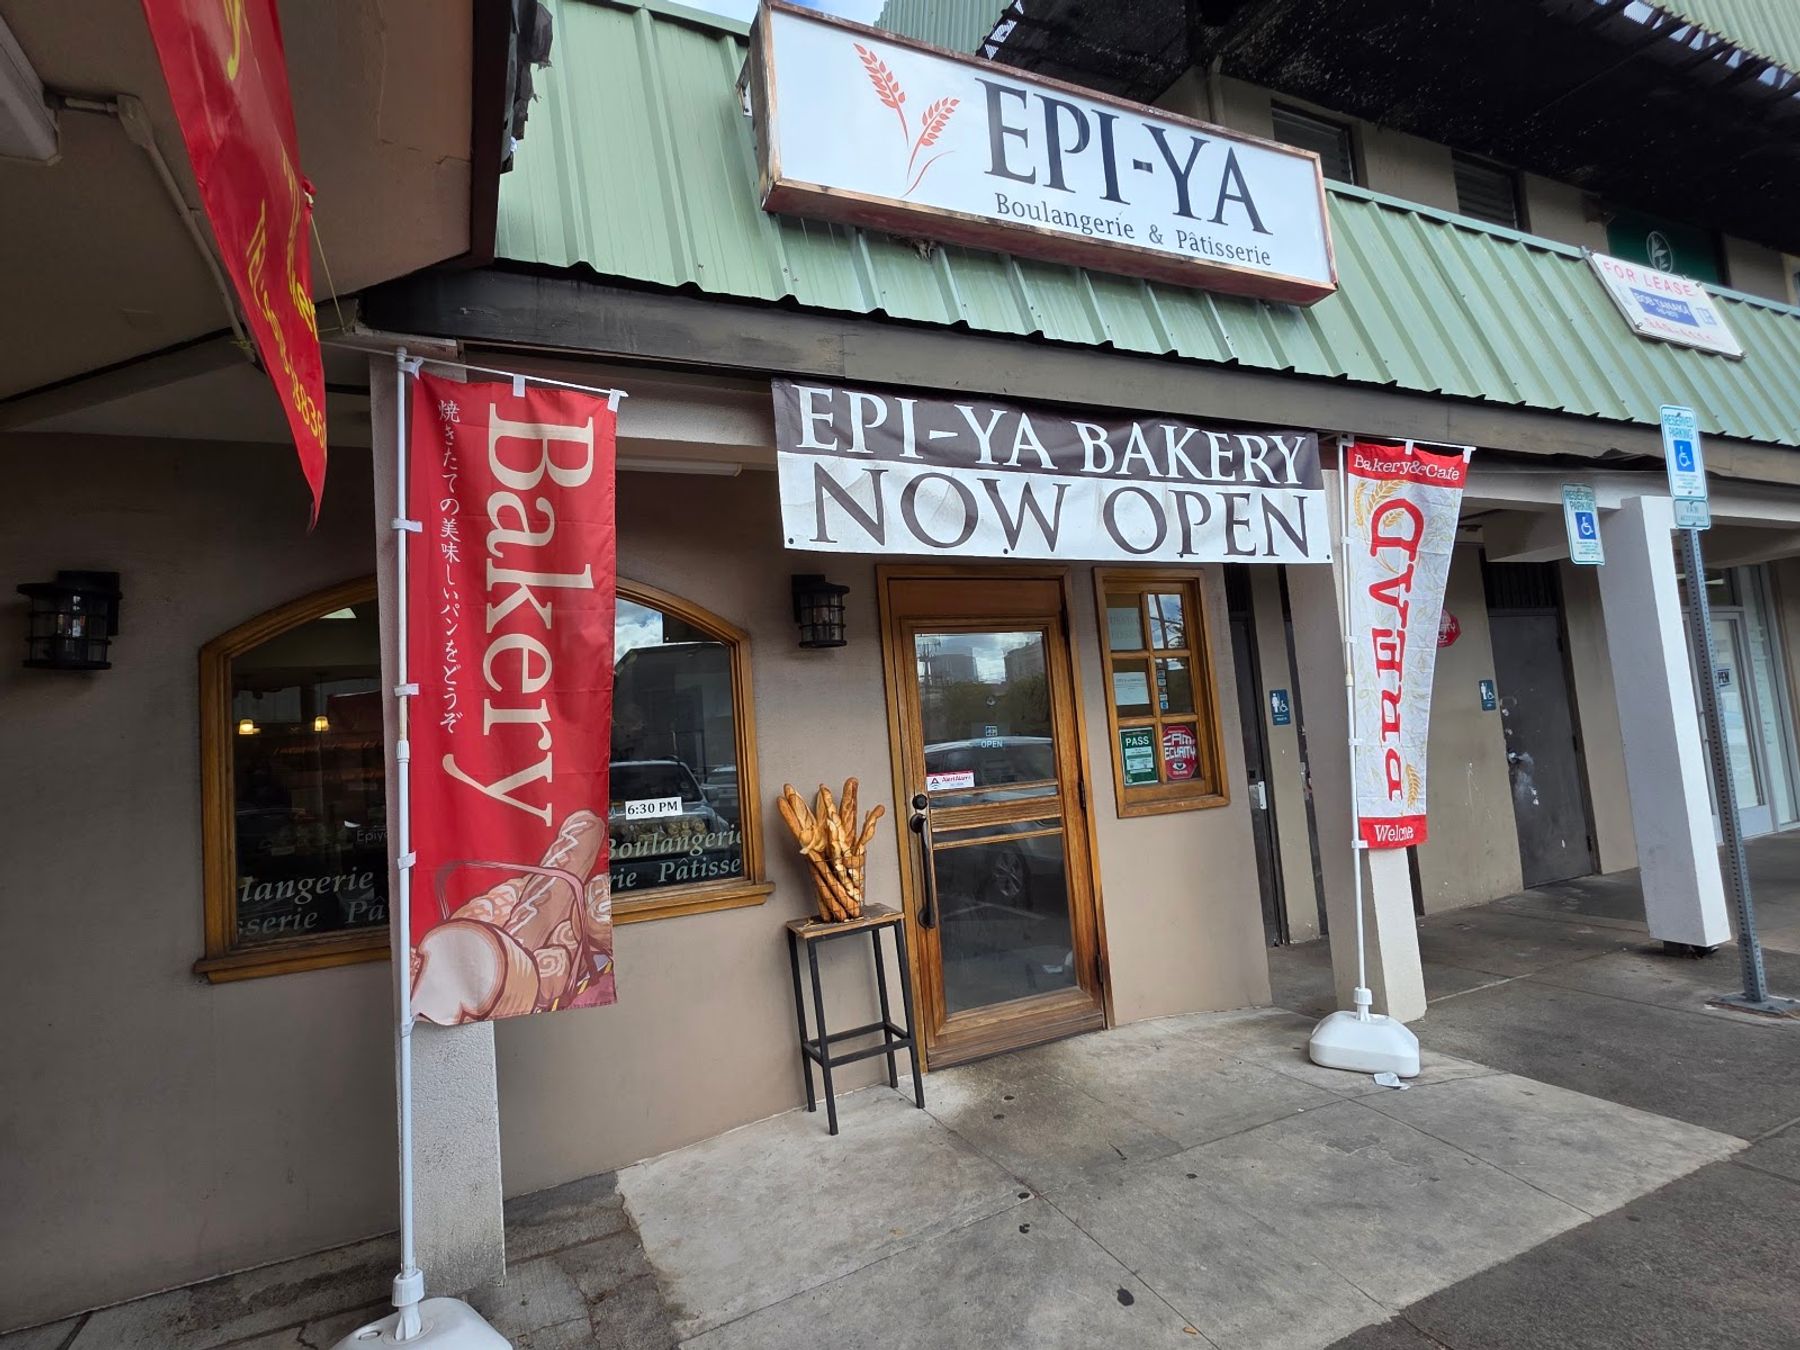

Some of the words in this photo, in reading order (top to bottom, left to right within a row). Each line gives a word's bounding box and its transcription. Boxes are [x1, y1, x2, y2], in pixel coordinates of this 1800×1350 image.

[975, 77, 1273, 236] EPI-YA
[995, 192, 1136, 240] Boulangerie
[1148, 223, 1164, 245] &
[1176, 228, 1272, 266] Pâtisserie
[1603, 261, 1637, 284] FOR
[1643, 273, 1696, 297] LEASE
[791, 384, 1059, 470] EPI-YA
[1071, 420, 1306, 485] BAKERY
[809, 461, 1072, 553] NOW
[1102, 486, 1310, 558] OPEN
[438, 398, 463, 735] 焼きたての美味しいパンをどうぞ
[442, 402, 595, 827] Bakery
[981, 740, 1003, 749] OPEN
[1125, 735, 1150, 747] PASS
[1164, 745, 1196, 761] ECURITY
[627, 803, 655, 816] 6:30
[658, 800, 679, 814] PM
